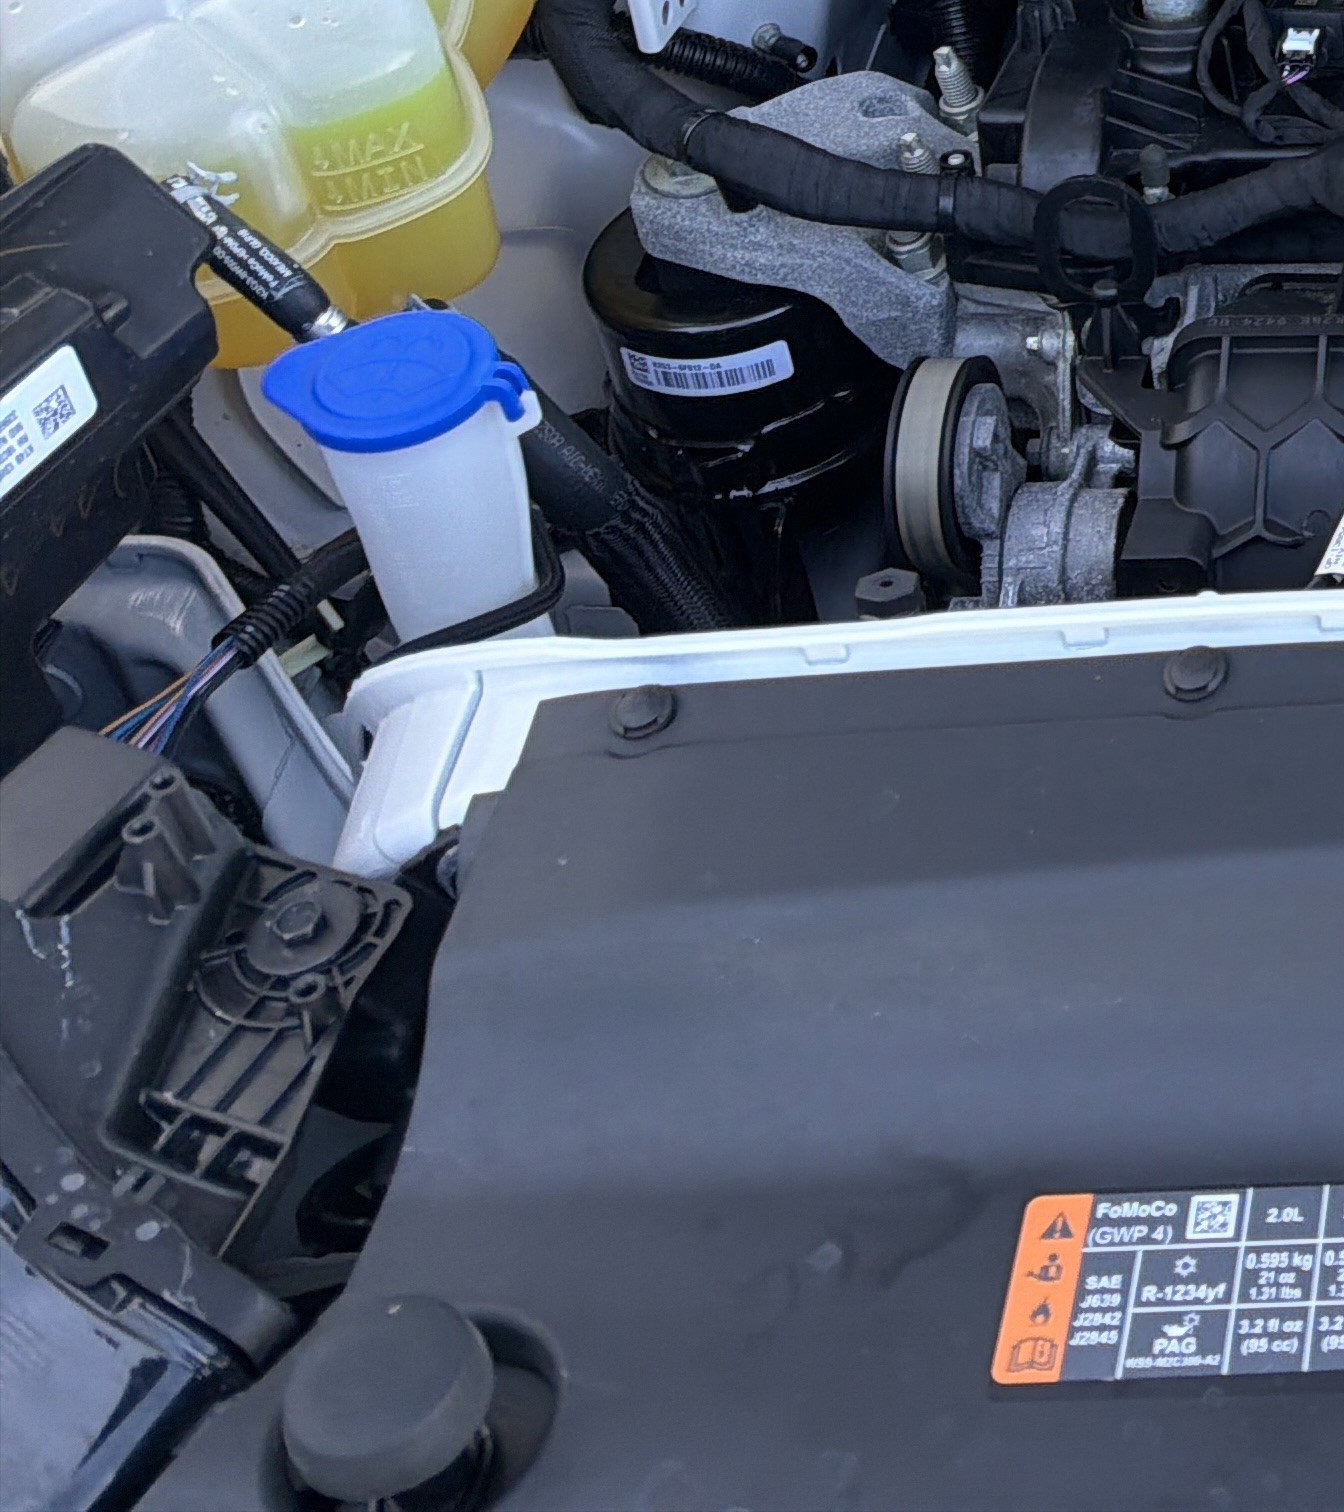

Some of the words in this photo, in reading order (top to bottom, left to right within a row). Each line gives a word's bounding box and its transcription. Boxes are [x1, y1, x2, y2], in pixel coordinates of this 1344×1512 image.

[330, 121, 420, 168] MAX
[345, 154, 429, 202] MIN
[1096, 1200, 1178, 1219] FoMoCo
[1265, 1206, 1304, 1223] 2.0L
[1087, 1225, 1149, 1247] (GWP
[1150, 1224, 1173, 1245] 4)
[1245, 1251, 1290, 1270] 0.595
[1292, 1251, 1314, 1272] kg
[1084, 1274, 1123, 1290] SAE
[1258, 1270, 1276, 1285] 21
[1278, 1271, 1297, 1284] oz
[1141, 1282, 1228, 1303] R-1234yf
[1279, 1285, 1302, 1300] lbs
[1238, 1318, 1265, 1335] 3.2
[1267, 1317, 1280, 1333] fl
[1282, 1319, 1304, 1333] oz
[1317, 1315, 1344, 1332] 3.2
[1152, 1337, 1196, 1354] PAG
[1271, 1335, 1299, 1355] cc)
